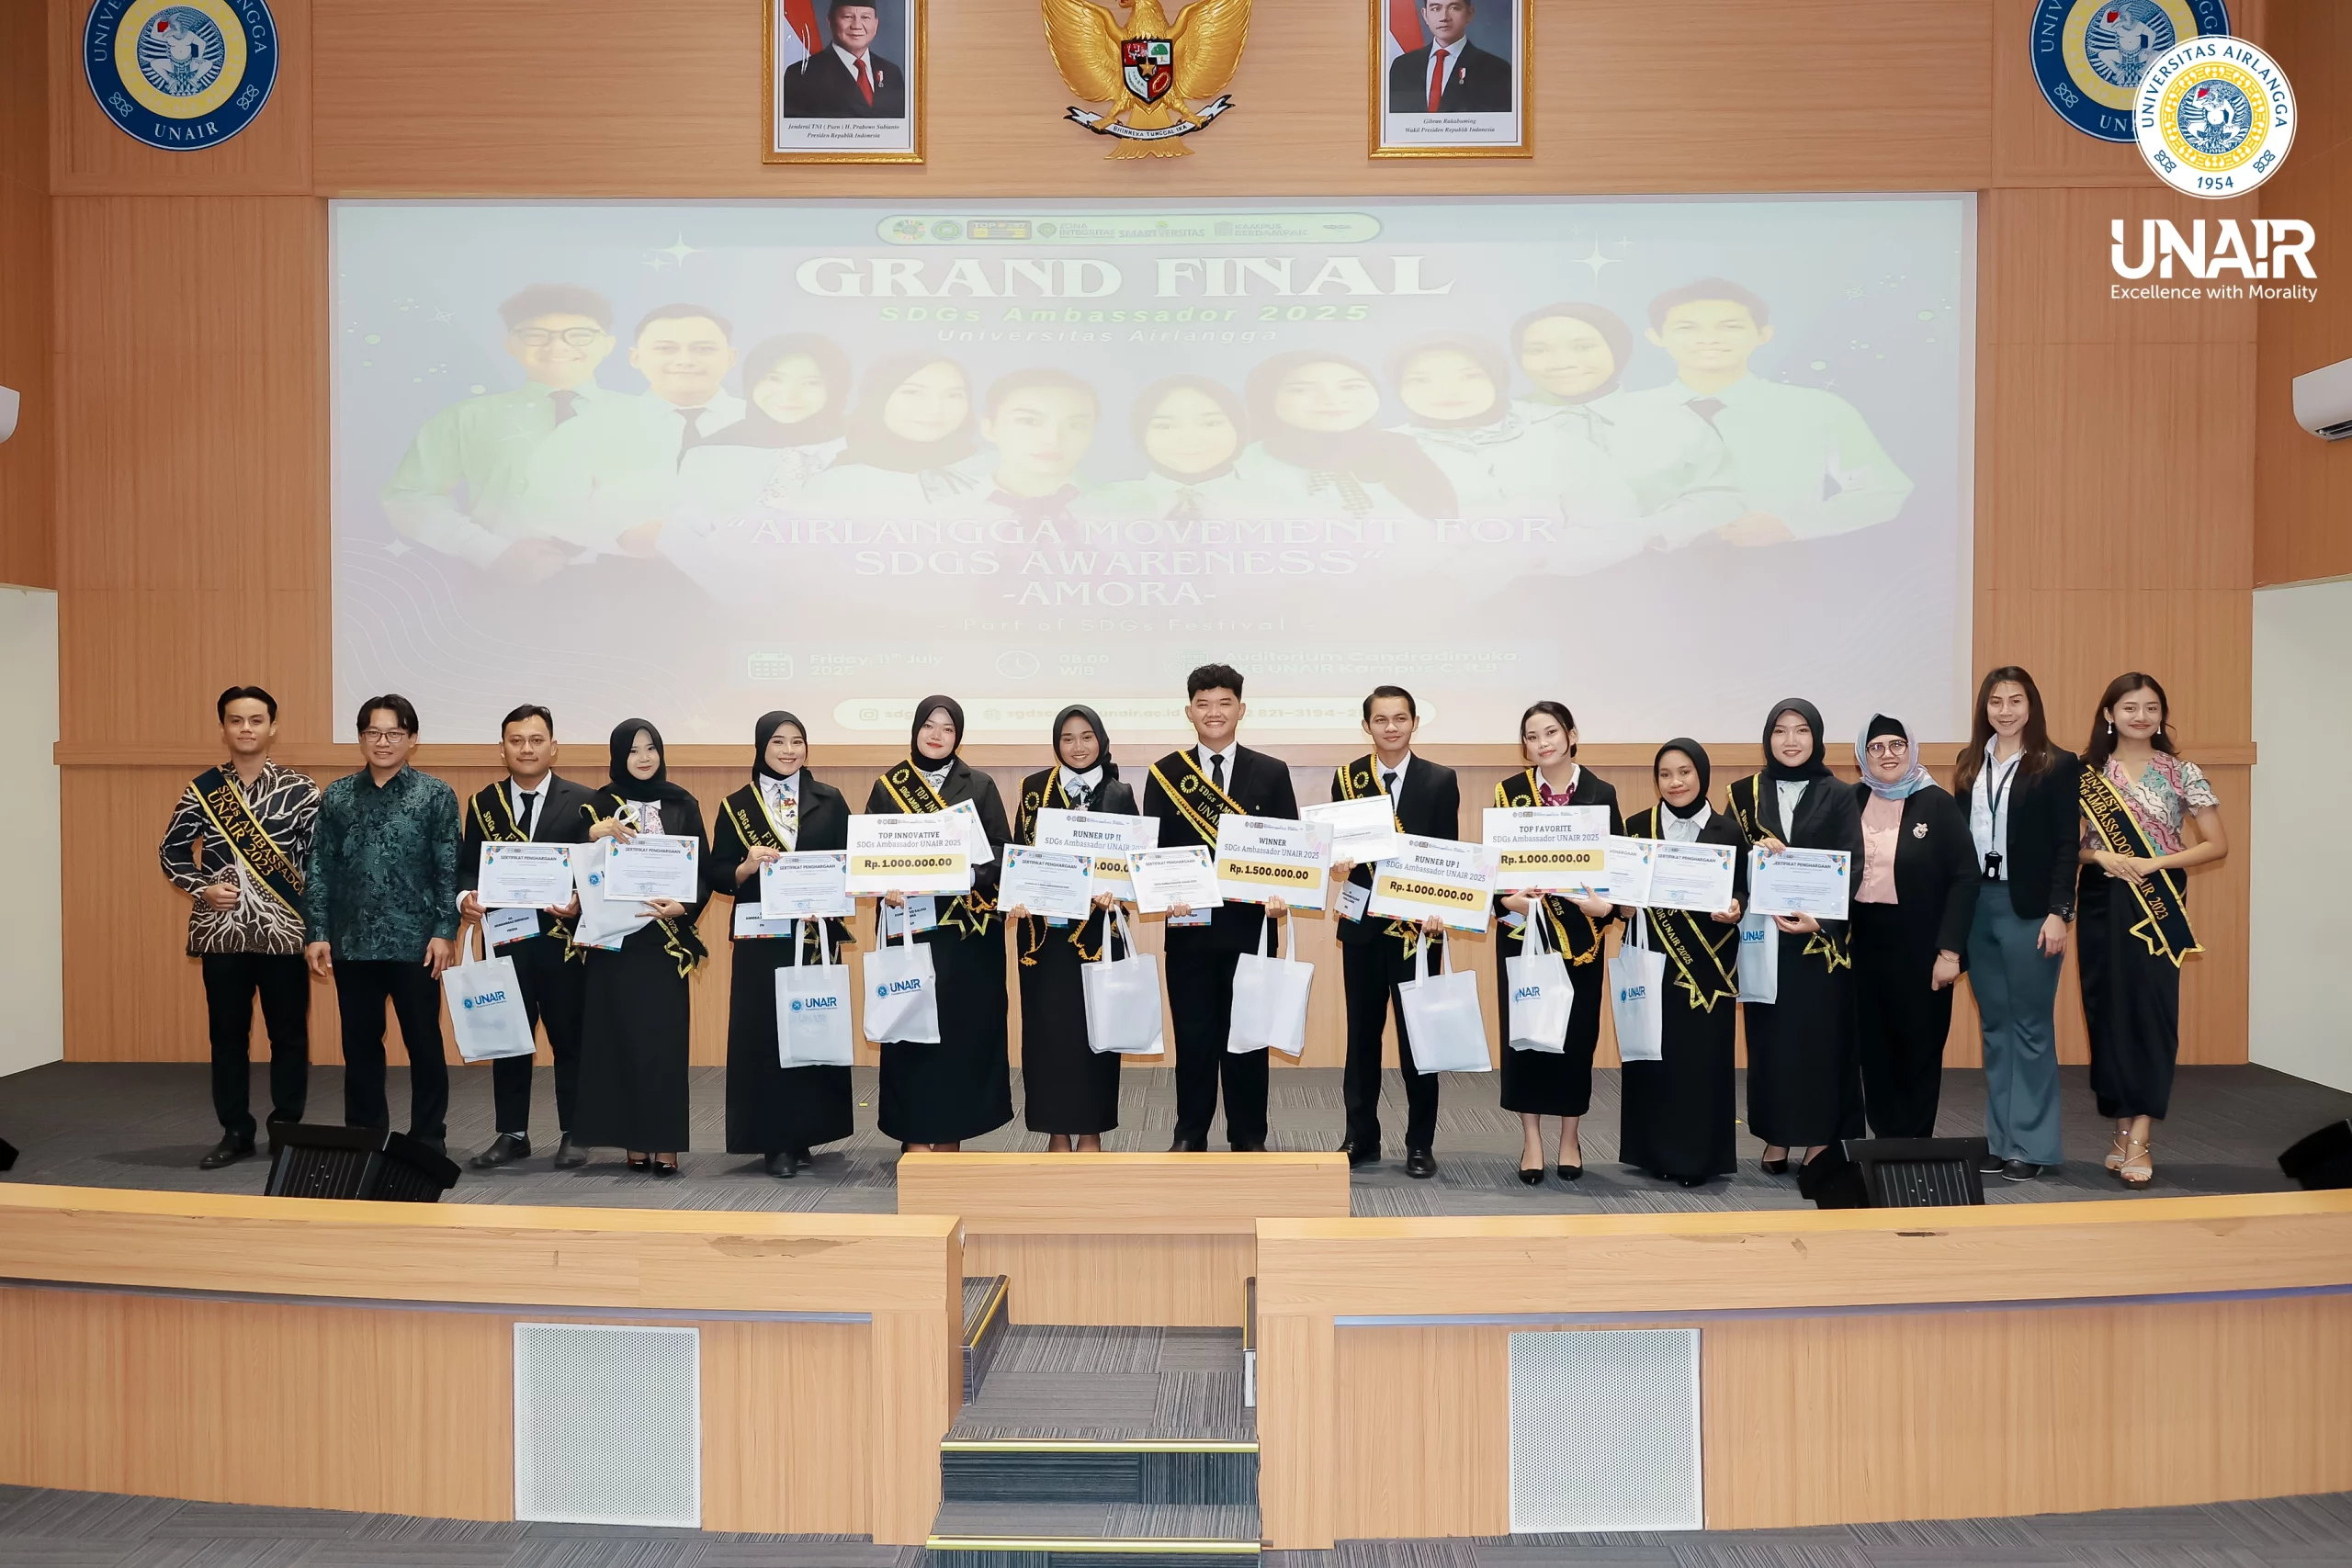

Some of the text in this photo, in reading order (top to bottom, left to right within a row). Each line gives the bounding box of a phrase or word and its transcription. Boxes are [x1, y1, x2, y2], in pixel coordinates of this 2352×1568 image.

[154, 122, 219, 141] UNAIR
[1113, 125, 1187, 137] BHINNEKA TUNGGAL IKA
[795, 255, 1456, 298] GRAND FINAL
[879, 304, 1370, 323] SDGs Ambassador 2025
[937, 329, 1279, 345] Universitas Airlangga
[1082, 518, 1408, 544] MOVEMENT
[1433, 517, 1557, 544] FOR
[854, 550, 1001, 575] SDGS
[1001, 581, 1217, 605] -AMORA-
[963, 615, 1286, 632] Part of SDGs Festival
[905, 654, 944, 667] July
[1224, 650, 1341, 662] Auditorium
[809, 666, 855, 677] 2025
[1269, 663, 1331, 673] UNAIR
[1341, 662, 1437, 675] Kampus
[914, 786, 930, 800] TOP
[1198, 784, 1216, 803] SDGs
[2082, 771, 2121, 814] FINALIST
[219, 784, 241, 817] SDGs
[737, 808, 751, 829] SDGs
[208, 790, 276, 875] UNAIR 2023
[894, 831, 941, 840] INNOVATIVE
[1073, 830, 1103, 840] RUNNER
[1492, 833, 1600, 843] SDGs Ambassador UNAIR 2025
[856, 839, 962, 849] SDGs Ambassador UNAIR 2025
[1045, 838, 1063, 846] SDGs
[1063, 840, 1105, 849] Ambassador
[1106, 842, 1130, 852] UNAIR
[1259, 837, 1287, 846] WINNER
[1224, 843, 1320, 860] SDGs Ambassador UNAIR 2025
[865, 860, 881, 870] Rp.
[1415, 855, 1444, 866] RUNNER
[1445, 860, 1455, 868] UP
[1500, 855, 1517, 865] Rp.
[1229, 863, 1244, 874] Rp.
[1385, 861, 1487, 883] SDGs Ambassador UNAIR 2025
[1389, 881, 1405, 893] Rp.
[2148, 897, 2169, 920] 2023
[1661, 919, 1680, 947] UNAIR
[1676, 945, 1694, 965] 2025
[1742, 931, 1765, 942] UNAIR
[889, 978, 922, 993] UNAIR
[1628, 986, 1646, 998] UNAIR
[474, 990, 506, 1006] UNAIR
[805, 997, 837, 1008] UNAIR
